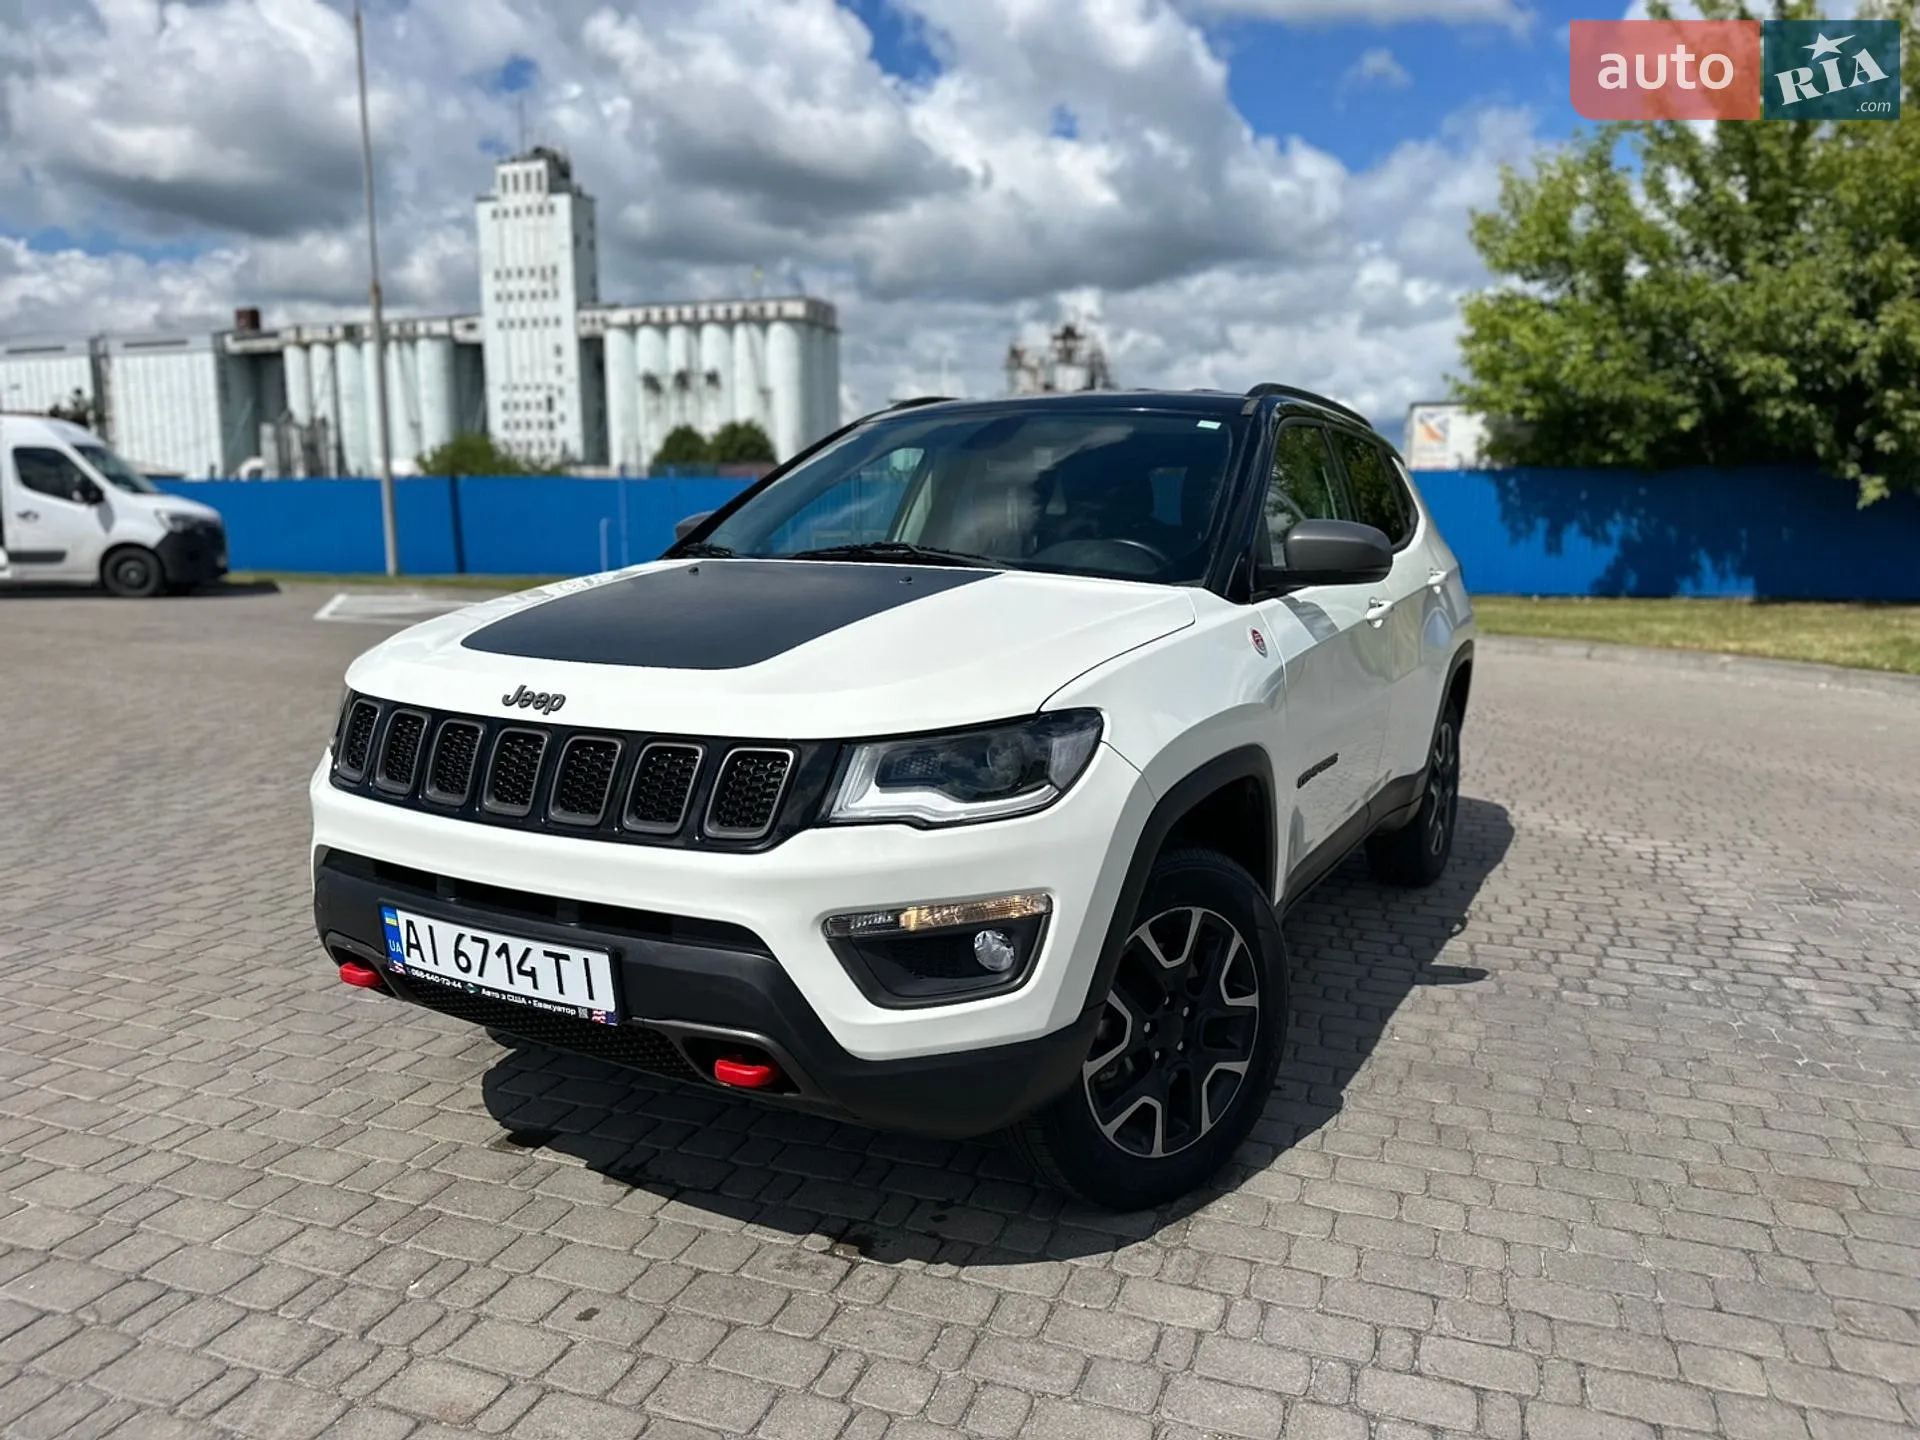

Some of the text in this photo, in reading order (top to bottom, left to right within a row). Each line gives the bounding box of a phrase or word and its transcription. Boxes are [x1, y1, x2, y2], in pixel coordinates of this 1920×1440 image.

[502, 684, 567, 716] Jeep
[388, 939, 403, 954] UA
[406, 919, 439, 967] AI
